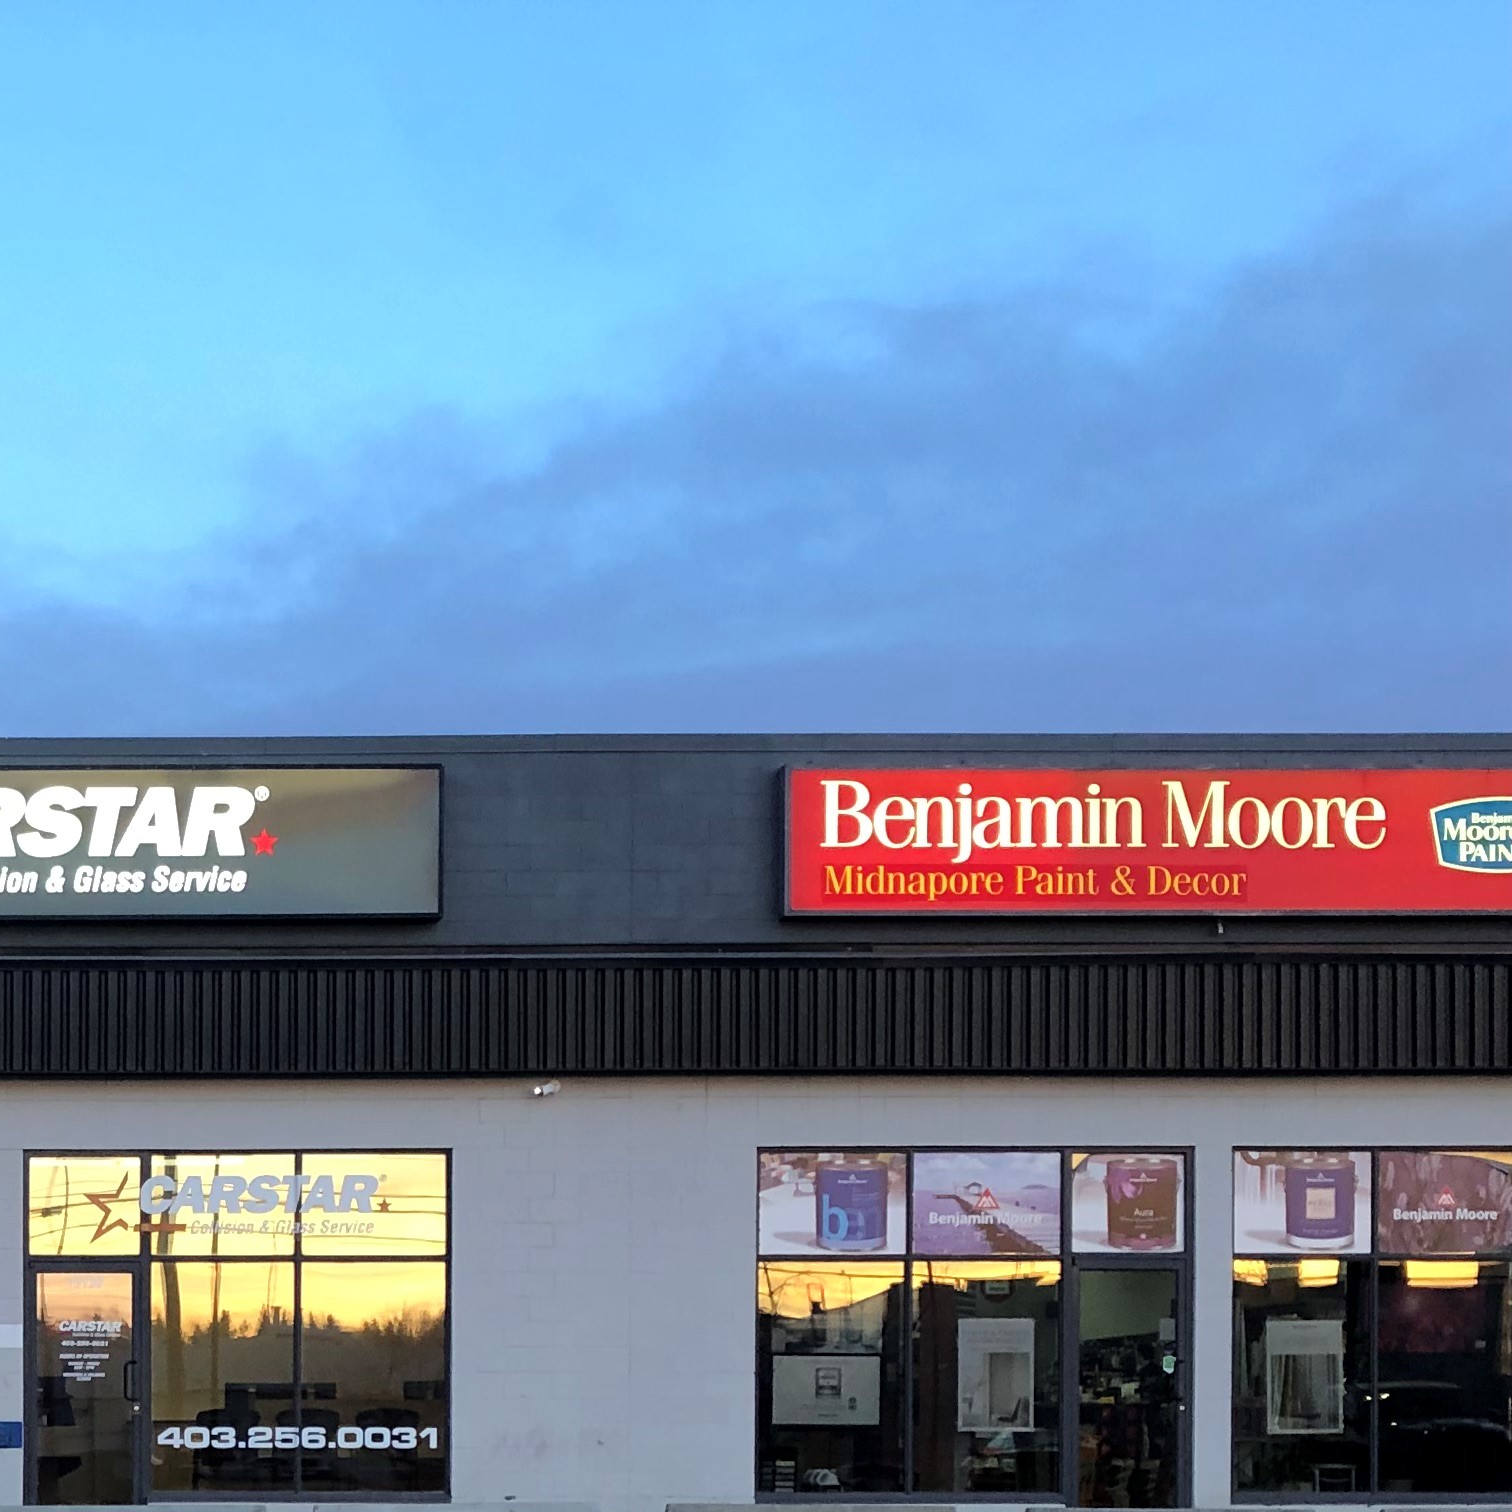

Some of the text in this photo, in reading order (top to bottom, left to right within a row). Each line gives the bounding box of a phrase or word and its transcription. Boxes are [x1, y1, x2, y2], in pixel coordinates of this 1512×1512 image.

[820, 780, 1386, 864] Benjamin Moore
[45, 867, 66, 893] &
[73, 866, 144, 893] Glass
[151, 865, 247, 893] Service
[824, 866, 1247, 901] Midnapore Paint & Decor
[140, 1174, 380, 1215] CARSTAR
[929, 1211, 994, 1227] Benjamin
[1393, 1207, 1498, 1223] Benjamin Moore
[276, 1220, 315, 1234] Glass
[320, 1220, 374, 1234] Service
[59, 1321, 122, 1332] CARSTAR
[157, 1427, 438, 1449] 403.256.0031
